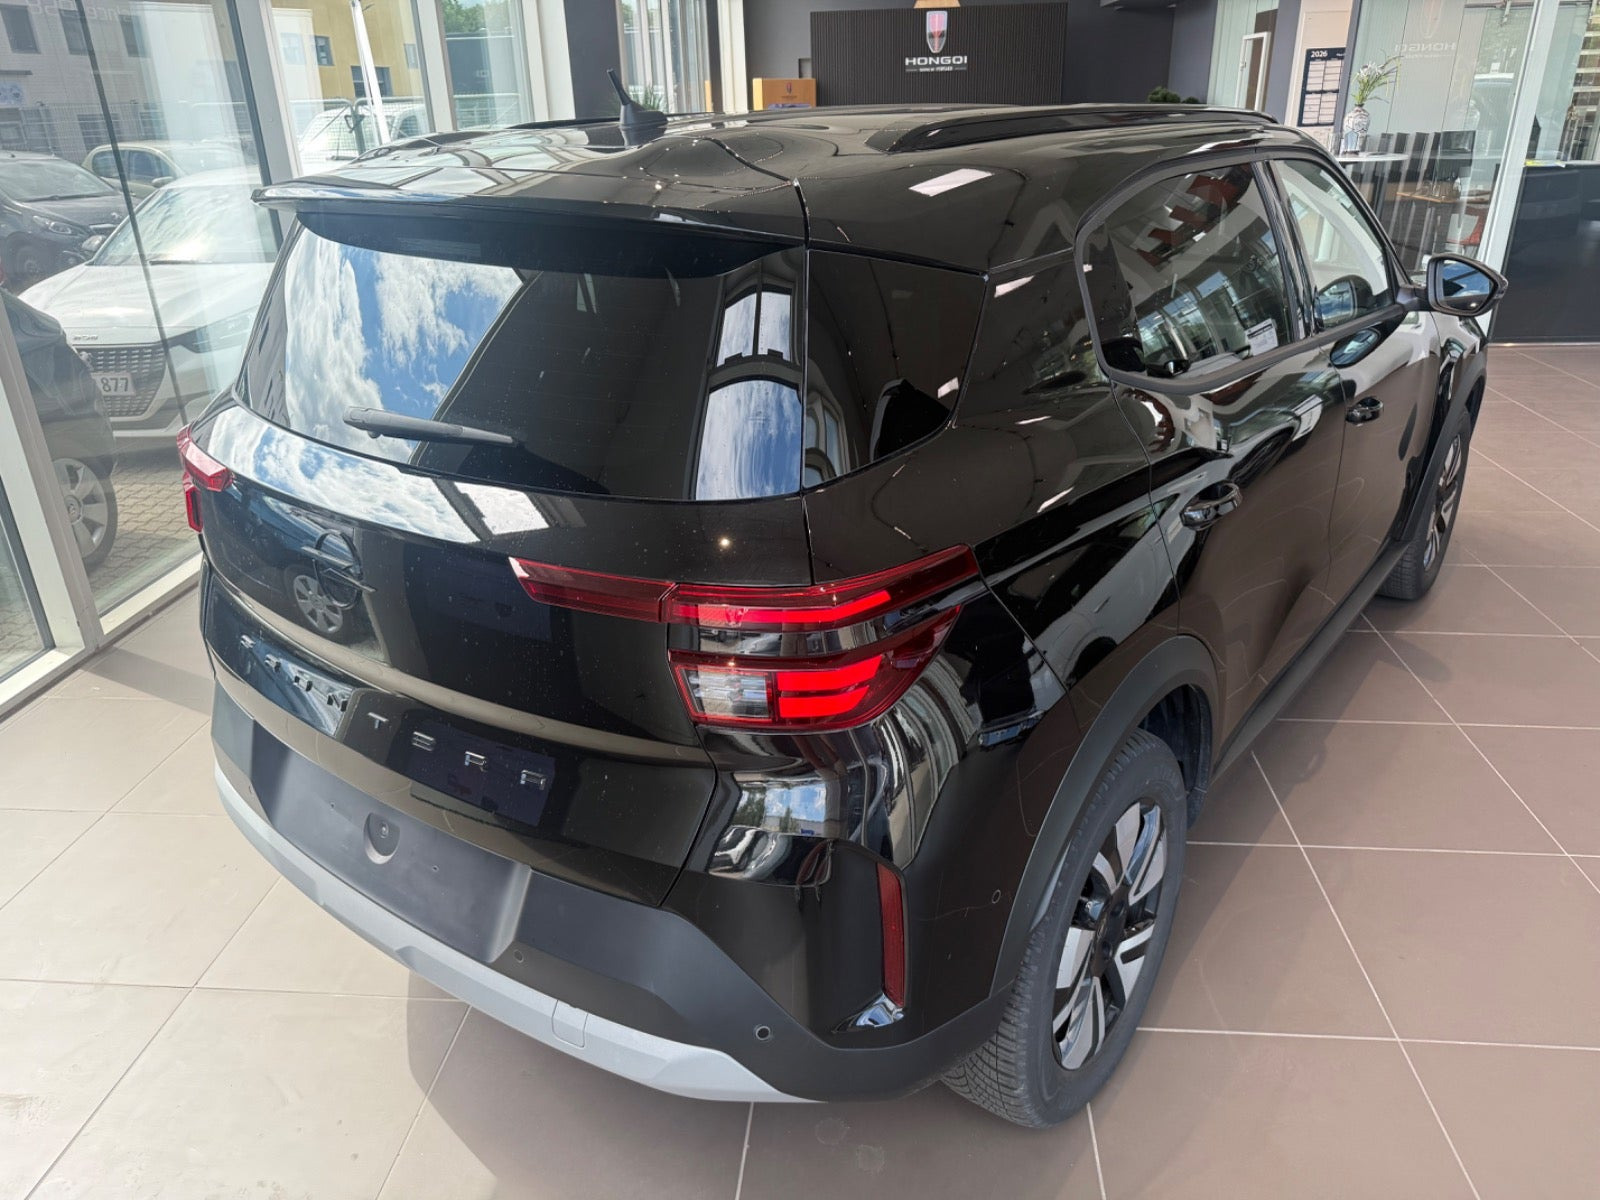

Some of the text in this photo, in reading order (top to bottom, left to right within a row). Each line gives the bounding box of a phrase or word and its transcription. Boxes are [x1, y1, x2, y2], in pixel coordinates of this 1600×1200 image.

[1310, 50, 1328, 58] 2026
[904, 55, 968, 66] HONGQI
[100, 377, 129, 393] 877
